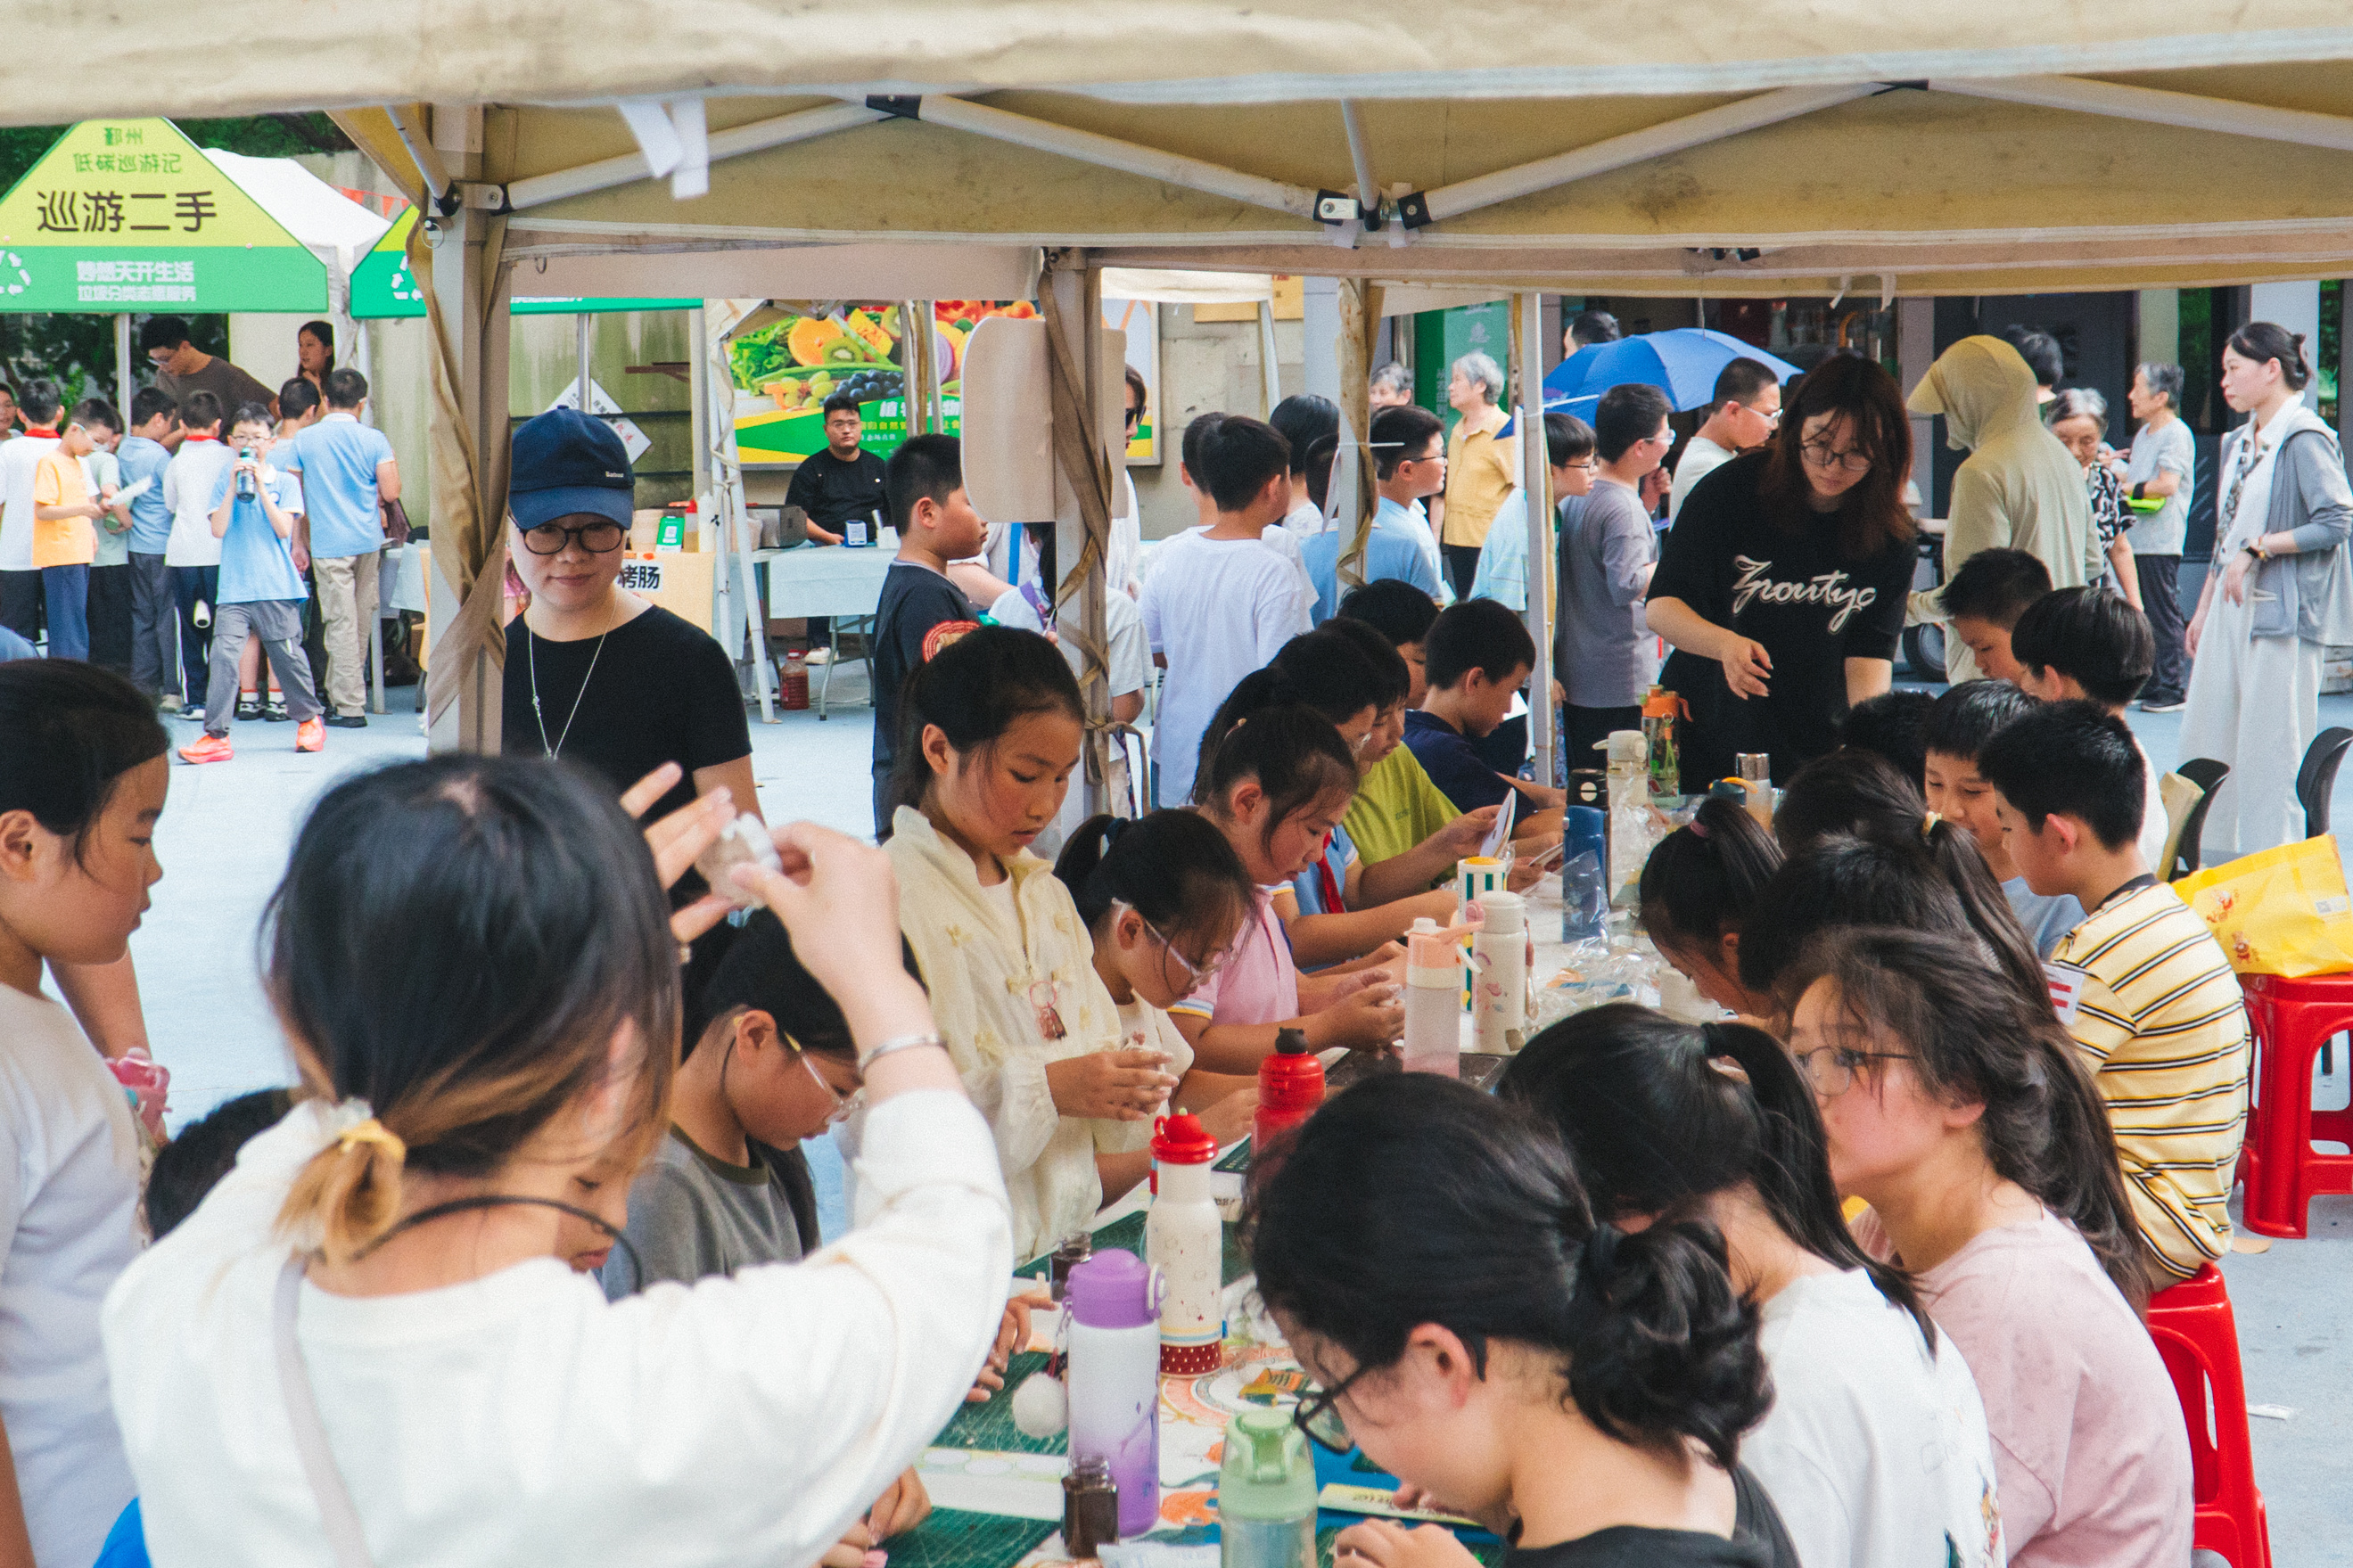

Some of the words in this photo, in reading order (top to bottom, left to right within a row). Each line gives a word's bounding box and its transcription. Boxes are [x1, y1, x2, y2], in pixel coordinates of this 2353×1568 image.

[73, 152, 183, 174] 低碳巡游记
[37, 190, 218, 233] 巡游二手
